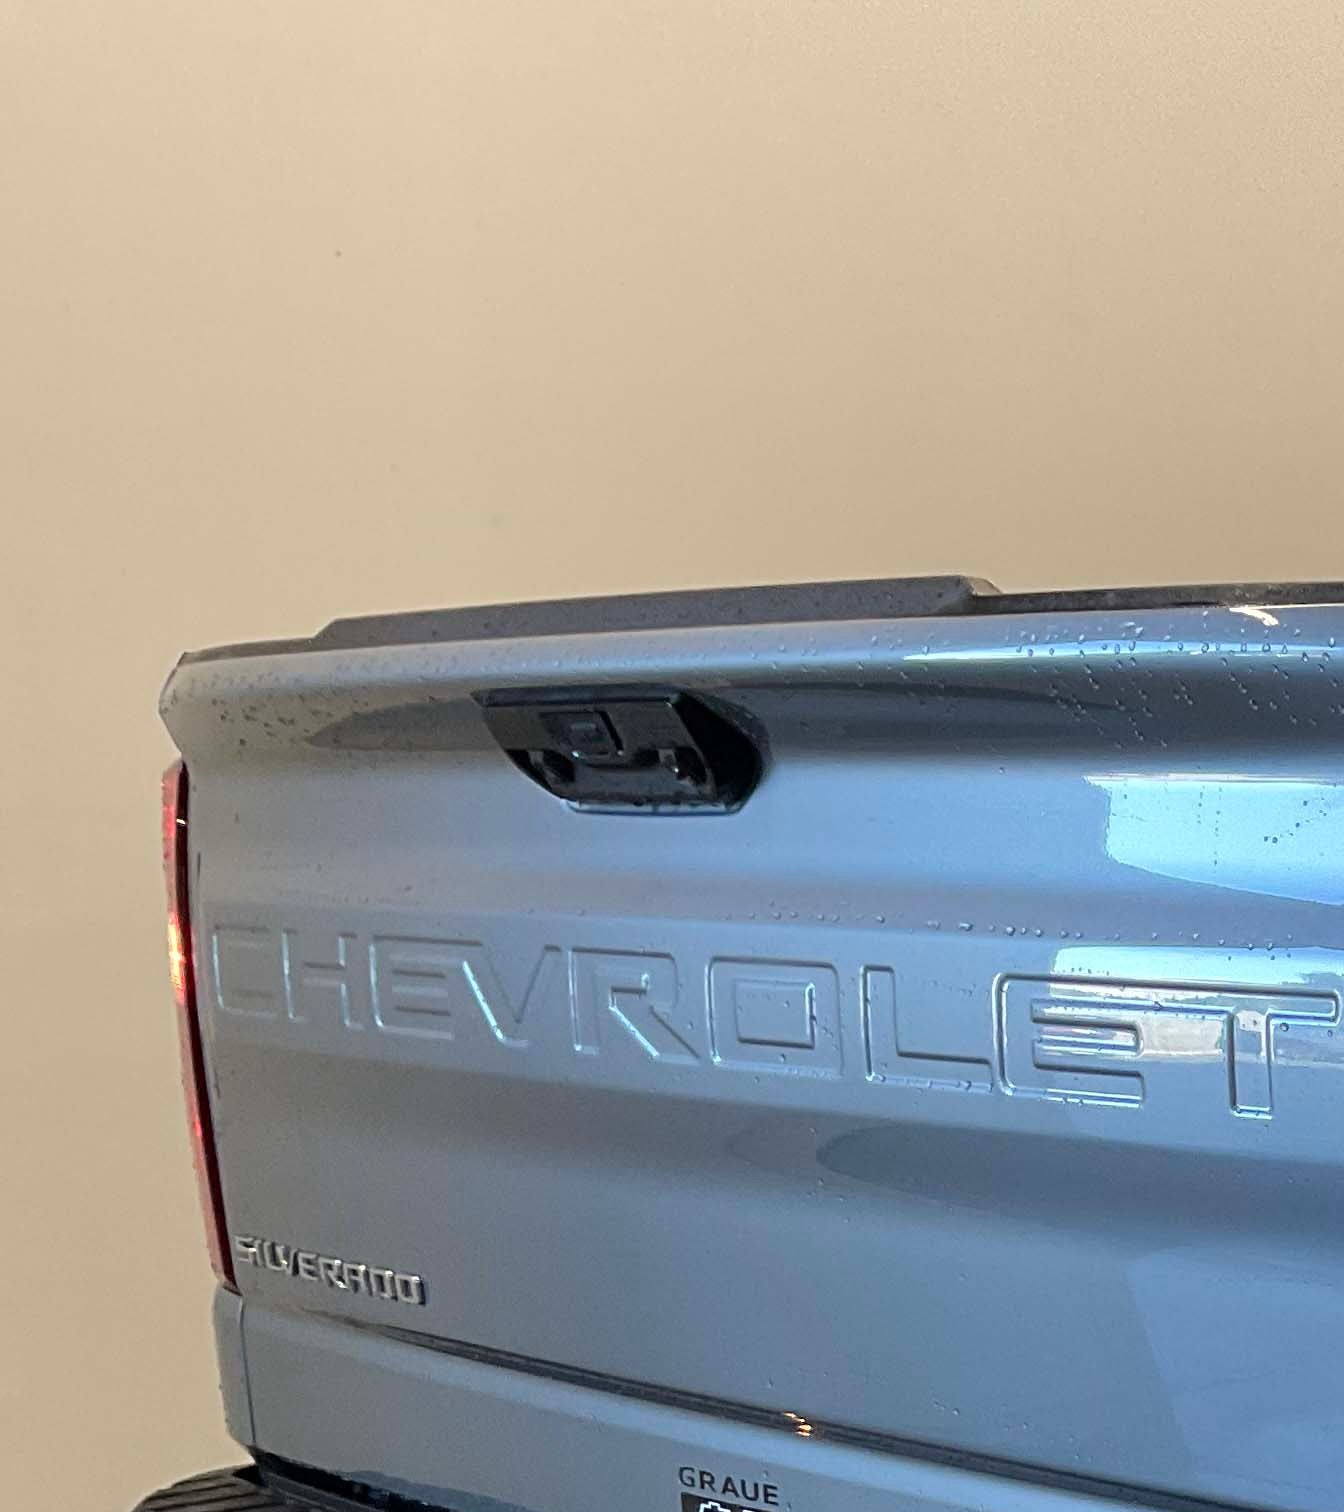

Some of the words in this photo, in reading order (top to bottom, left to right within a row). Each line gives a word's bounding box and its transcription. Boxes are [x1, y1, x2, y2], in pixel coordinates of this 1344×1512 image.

[211, 922, 1341, 1120] CHEVROLET
[233, 1235, 426, 1305] SILVERADO
[678, 1466, 780, 1507] GRAUE
